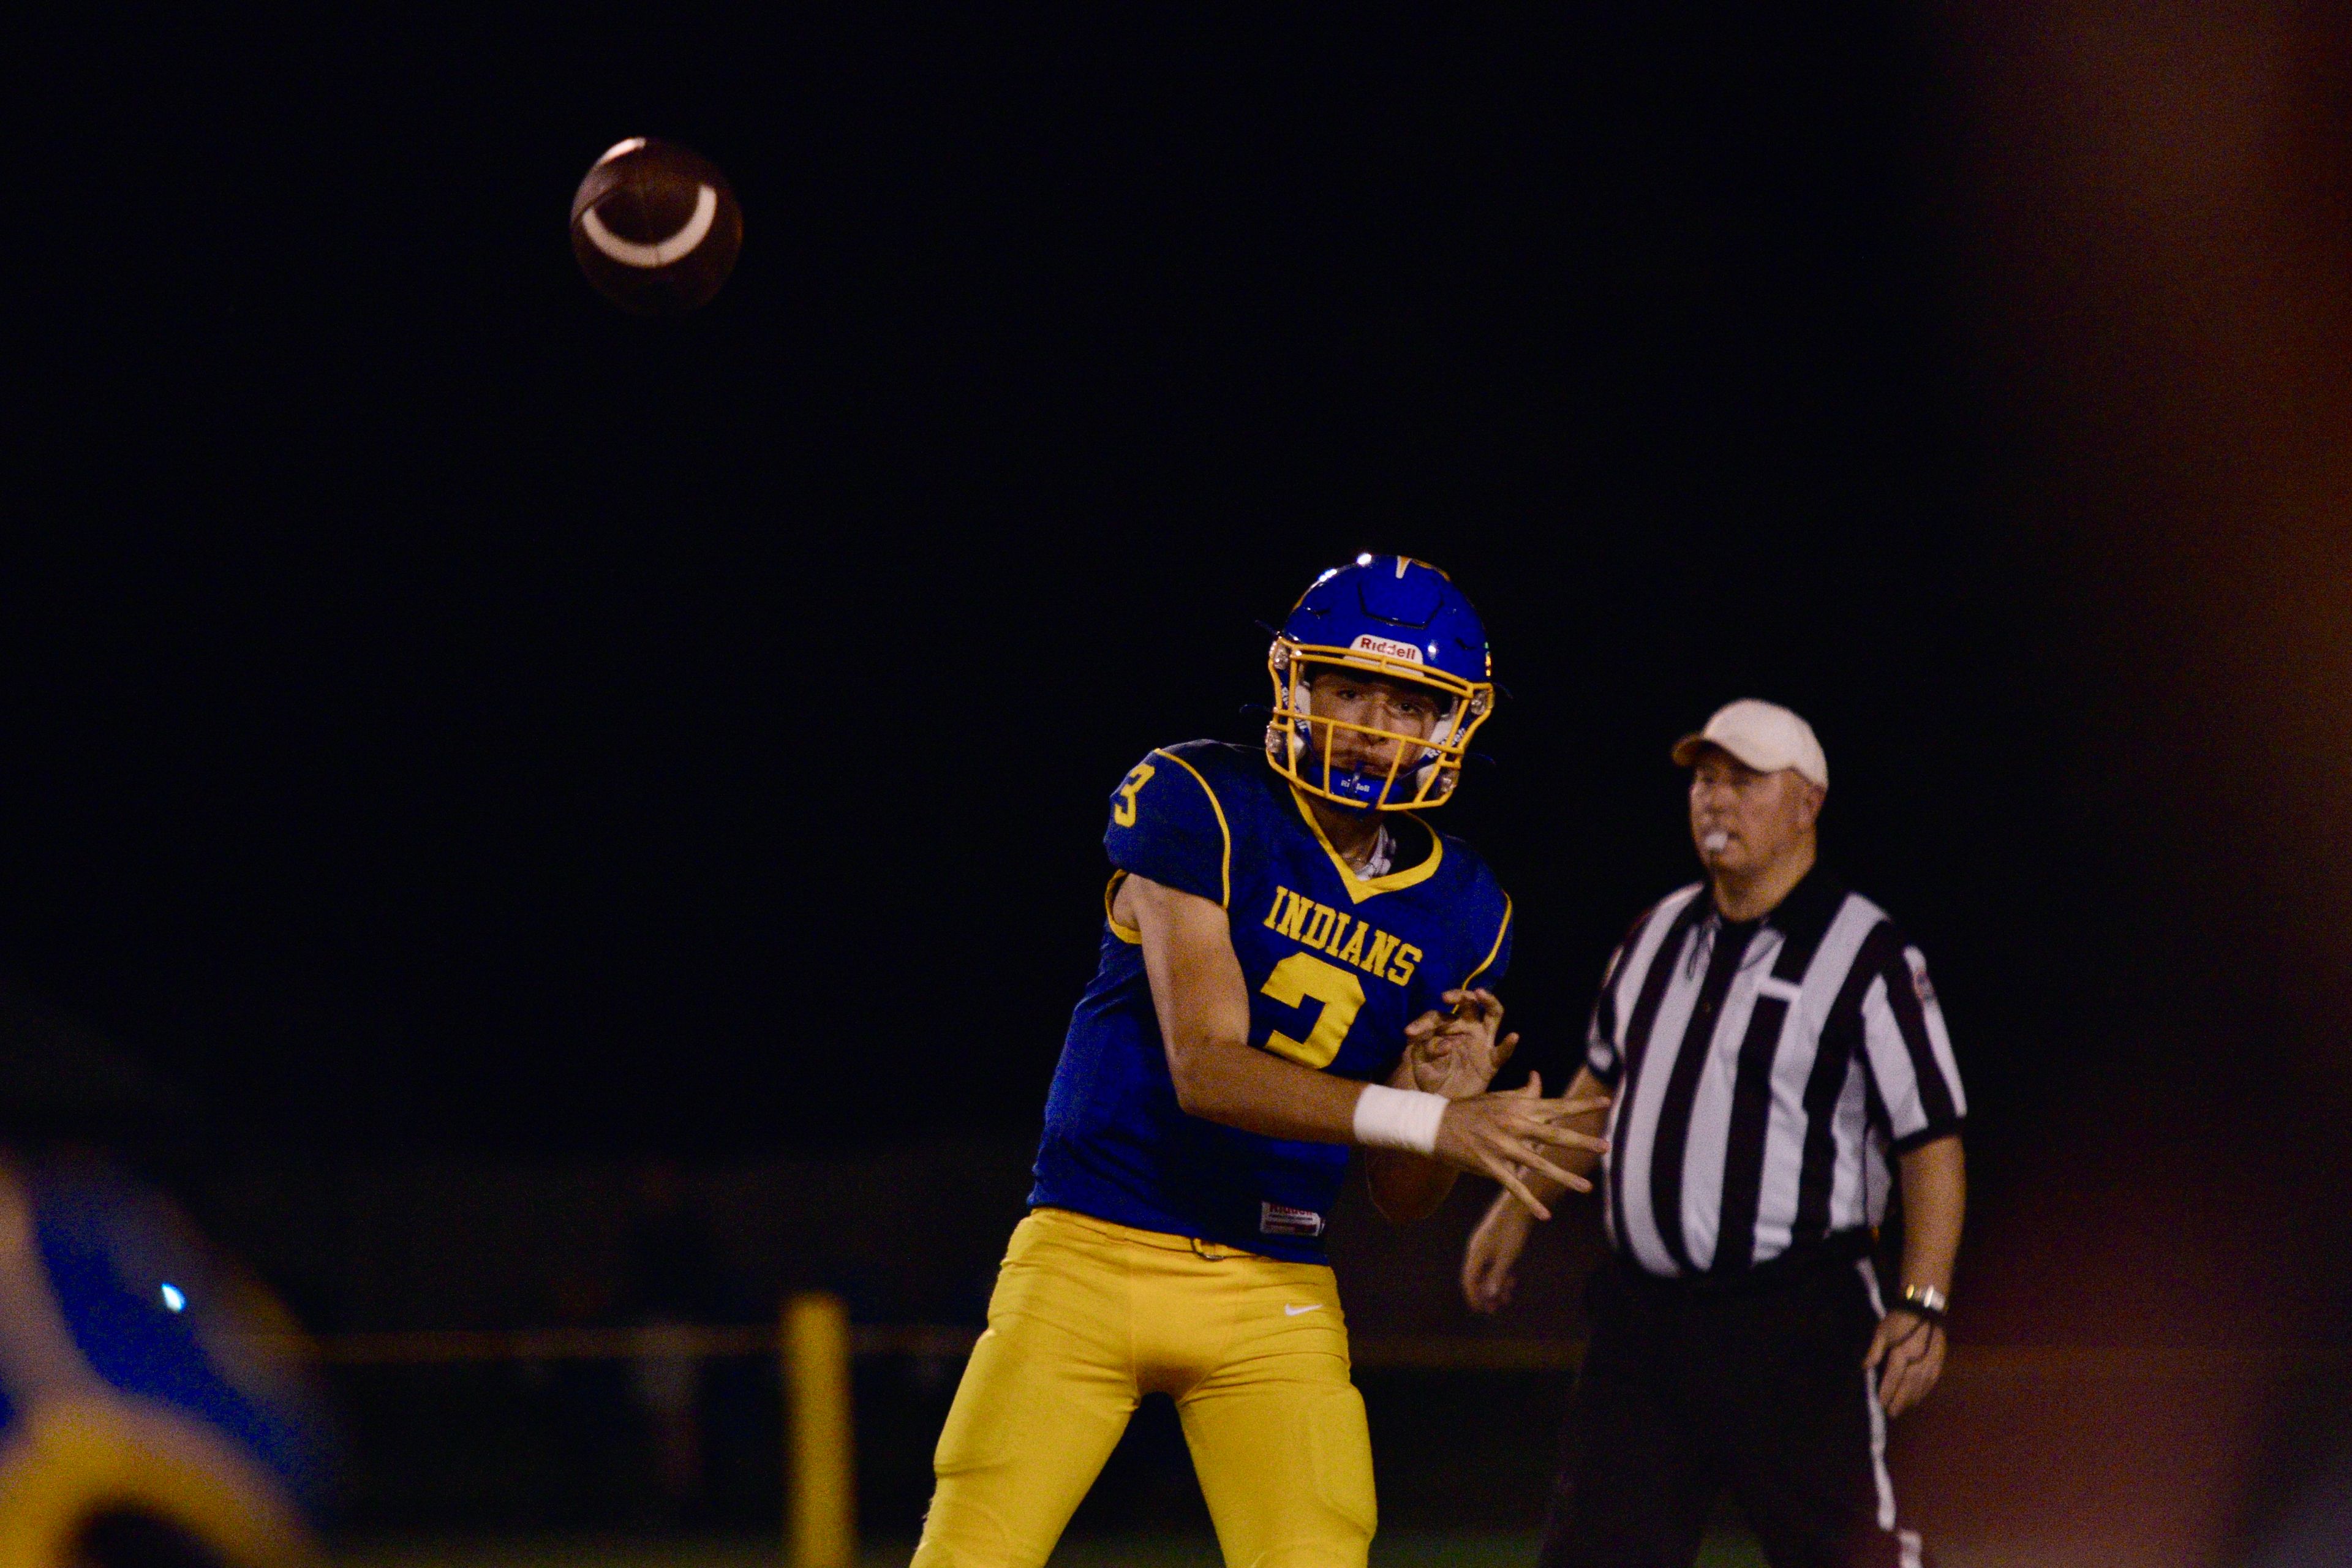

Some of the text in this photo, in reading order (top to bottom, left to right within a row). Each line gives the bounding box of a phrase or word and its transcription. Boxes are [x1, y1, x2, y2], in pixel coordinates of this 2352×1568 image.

[1360, 637, 1416, 660] Riddell
[1114, 764, 1156, 828] 3
[1262, 884, 1423, 987] INDIANS
[1259, 951, 1367, 1068] 3
